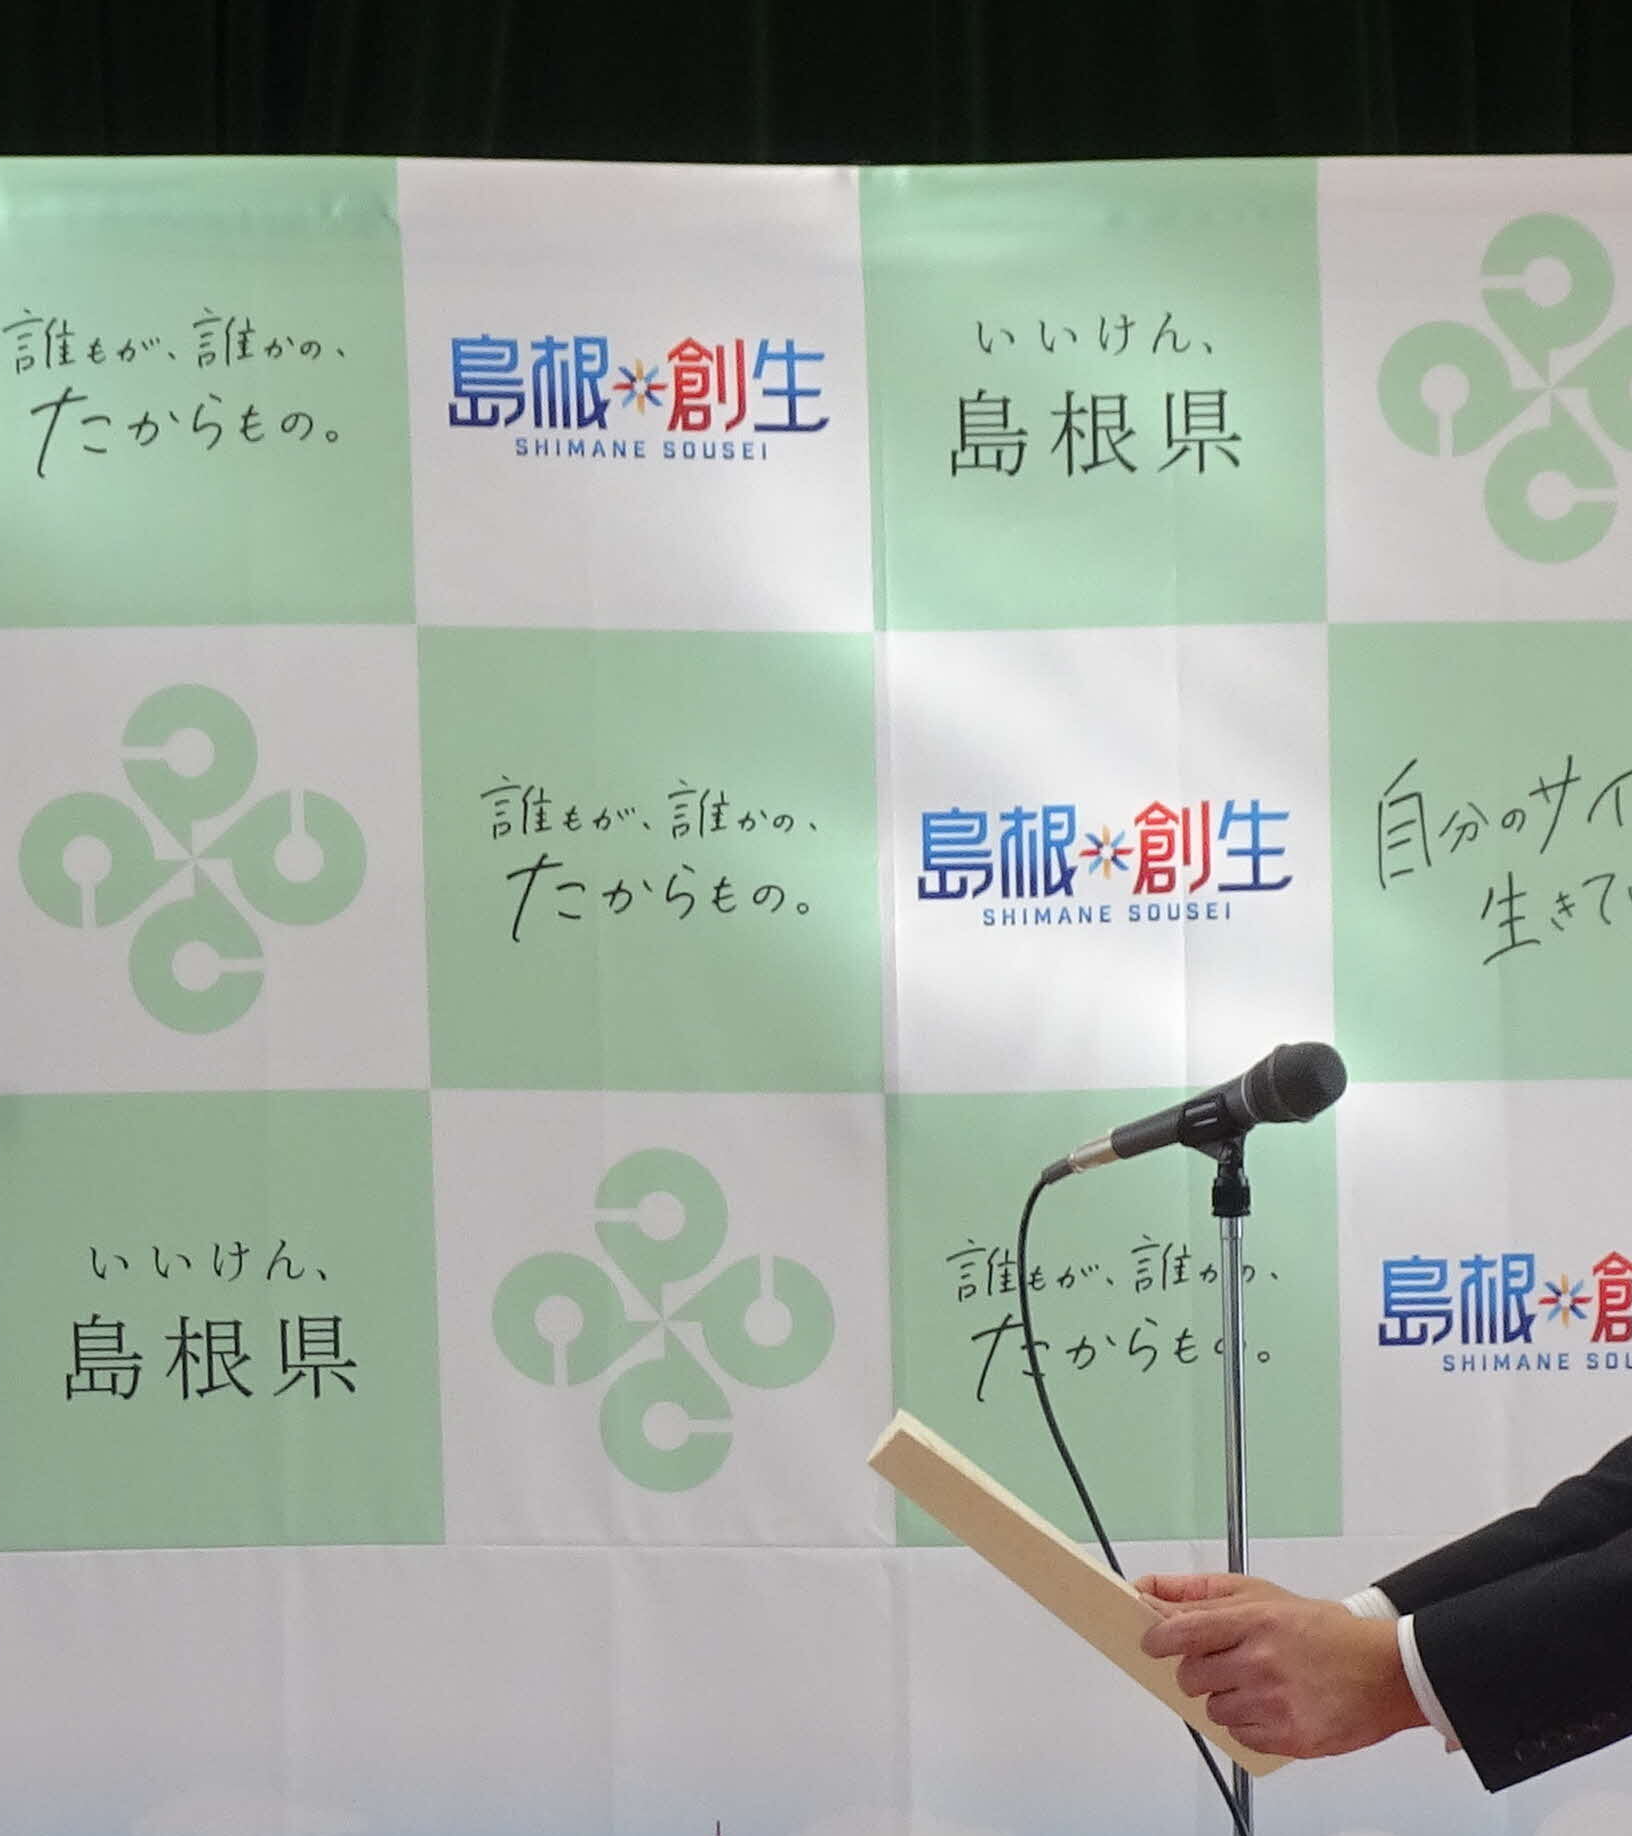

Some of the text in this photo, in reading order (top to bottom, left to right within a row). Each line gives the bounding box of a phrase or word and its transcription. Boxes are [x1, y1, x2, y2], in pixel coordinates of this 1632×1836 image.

[2, 307, 344, 372] 誰もが、誰かの、
[977, 312, 1212, 355] いいけん、
[30, 386, 338, 479] たからもの。
[516, 438, 767, 460] SHIMANE SOUSEI
[951, 389, 1241, 477] 島根県
[480, 775, 817, 840] 誰もが、誰かの、
[506, 853, 809, 943] たからもの。
[983, 902, 1230, 926] SHIMANE SOUSEI
[90, 1239, 327, 1281] いいけん、
[66, 1314, 356, 1400] 島根県
[1443, 1353, 1569, 1372] SHIMANE
